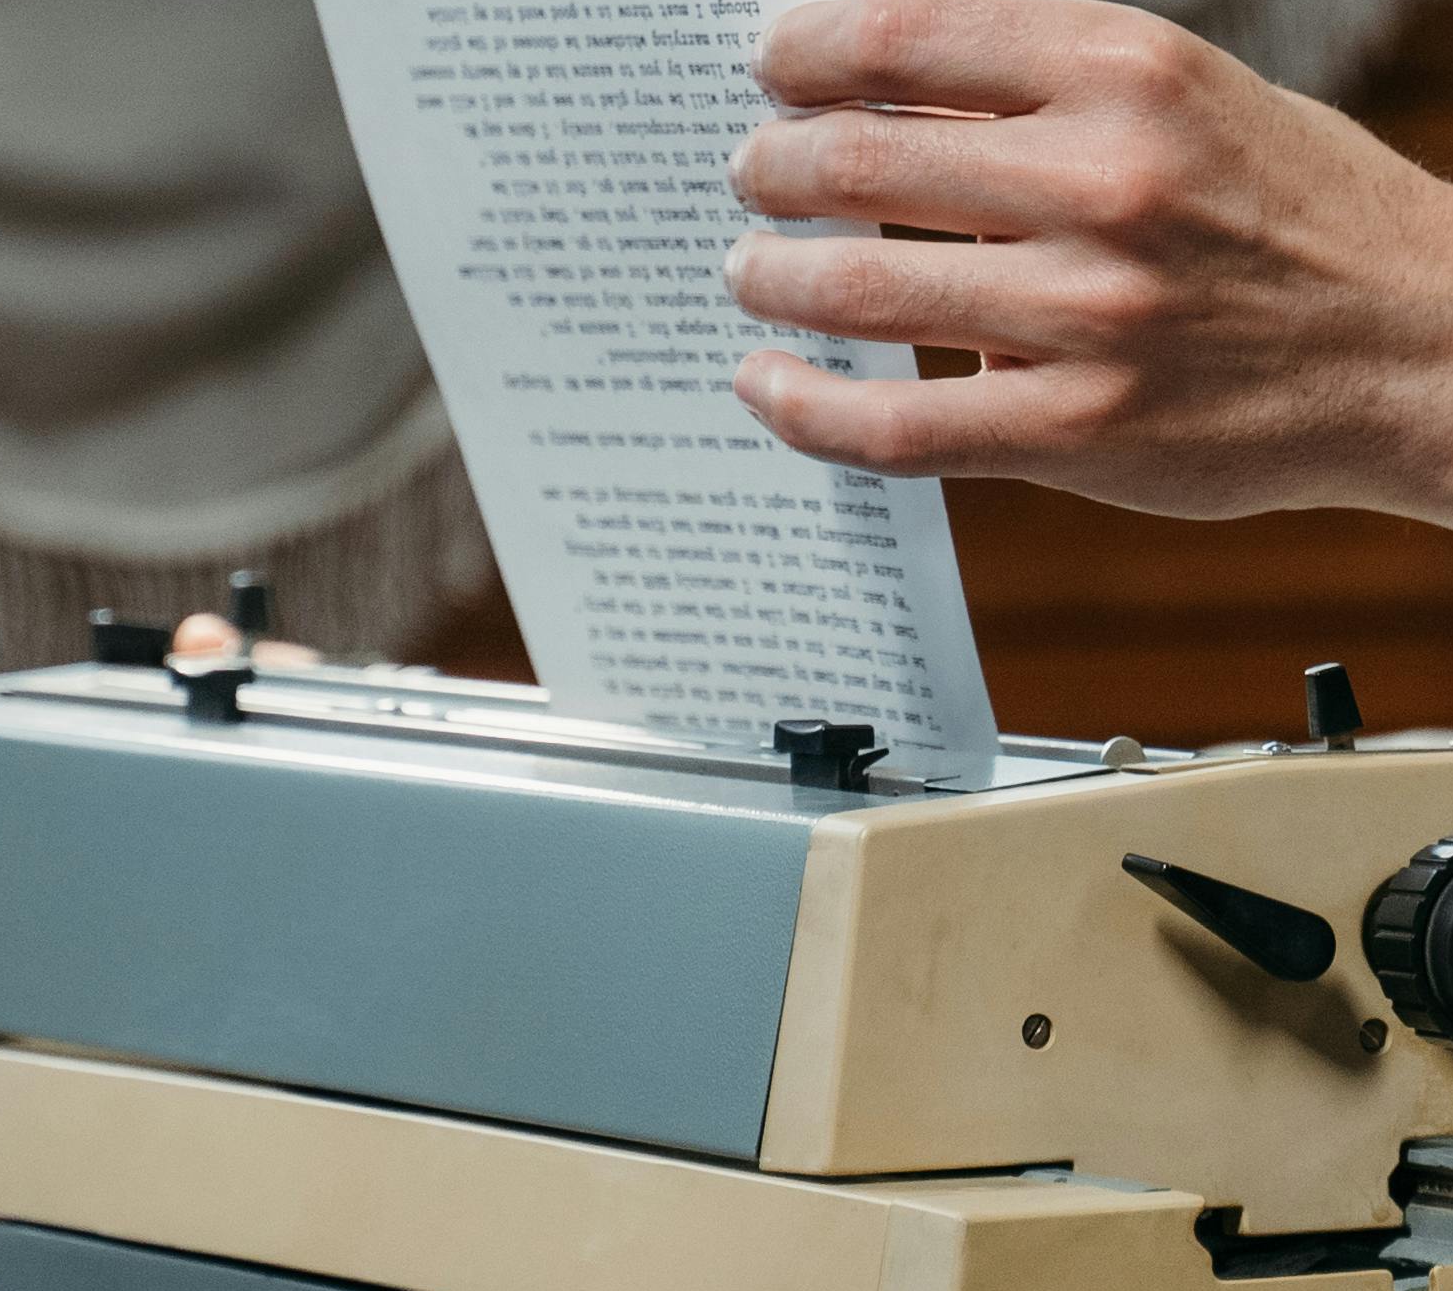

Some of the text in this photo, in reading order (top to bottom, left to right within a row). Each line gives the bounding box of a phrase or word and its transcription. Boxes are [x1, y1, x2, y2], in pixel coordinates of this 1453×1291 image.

[583, 6, 592, 19] a
[618, 5, 654, 20] throw
[659, 4, 689, 18] must
[695, 4, 703, 20] I
[586, 34, 647, 50] whichever
[652, 30, 710, 47] marrying
[716, 33, 740, 47] his
[688, 63, 724, 78] lines
[553, 95, 574, 107] see
[668, 94, 685, 108] be
[689, 94, 719, 109] will
[726, 122, 747, 134] are
[694, 238, 716, 250] are
[826, 357, 853, 371] when
[764, 438, 773, 452] a
